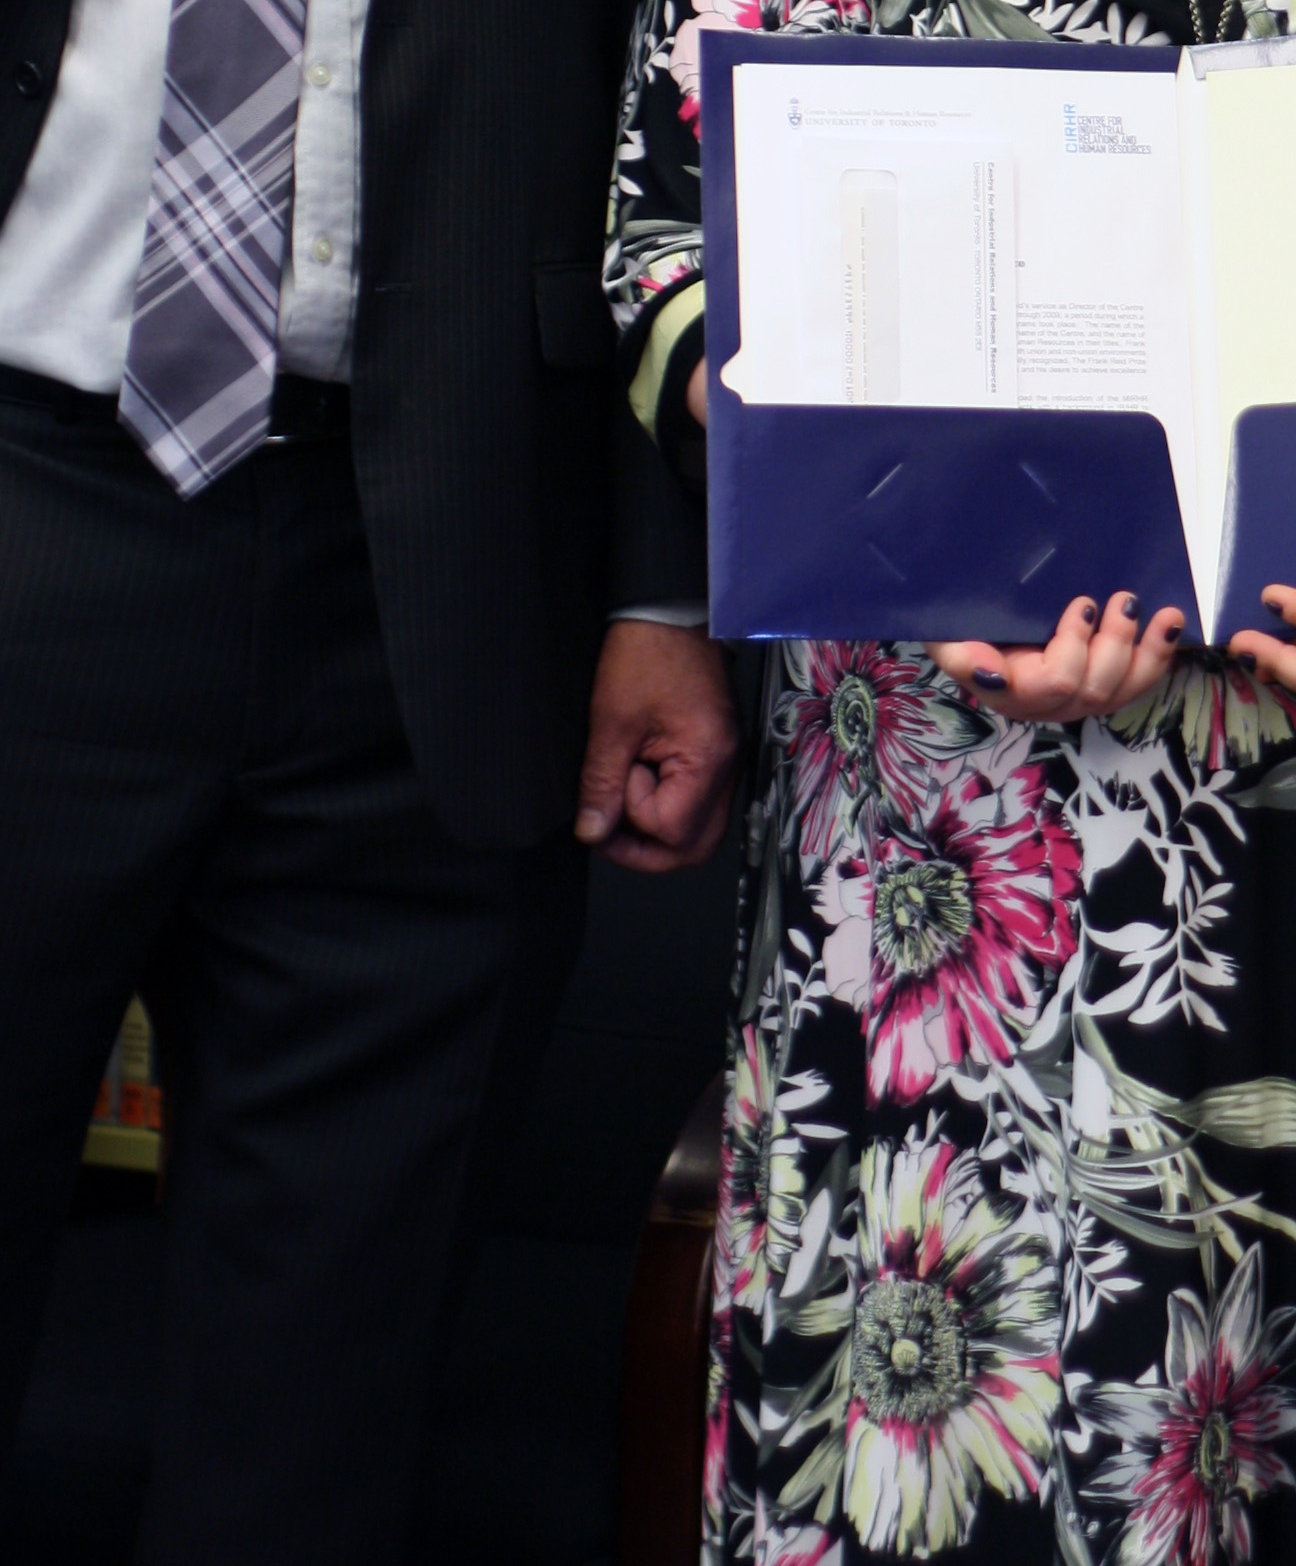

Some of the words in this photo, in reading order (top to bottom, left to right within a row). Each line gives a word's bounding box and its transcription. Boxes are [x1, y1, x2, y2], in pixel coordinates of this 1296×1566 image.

[804, 118, 867, 126] UNIVERSITY
[1063, 104, 1078, 153] CIRHR
[1078, 116, 1105, 125] CENTRE
[1108, 116, 1122, 125] FOR
[1079, 135, 1119, 144] RELATIONS
[1121, 135, 1136, 144] AND
[1079, 145, 1106, 153] HUMAN
[1108, 145, 1151, 154] RESOURCES
[972, 162, 982, 202] University
[987, 162, 995, 191] Centre
[974, 204, 982, 213] of
[988, 208, 996, 249] Industrial
[988, 252, 997, 292] Relations
[989, 295, 997, 311] and
[989, 314, 997, 344] Human
[989, 347, 998, 393] Resources
